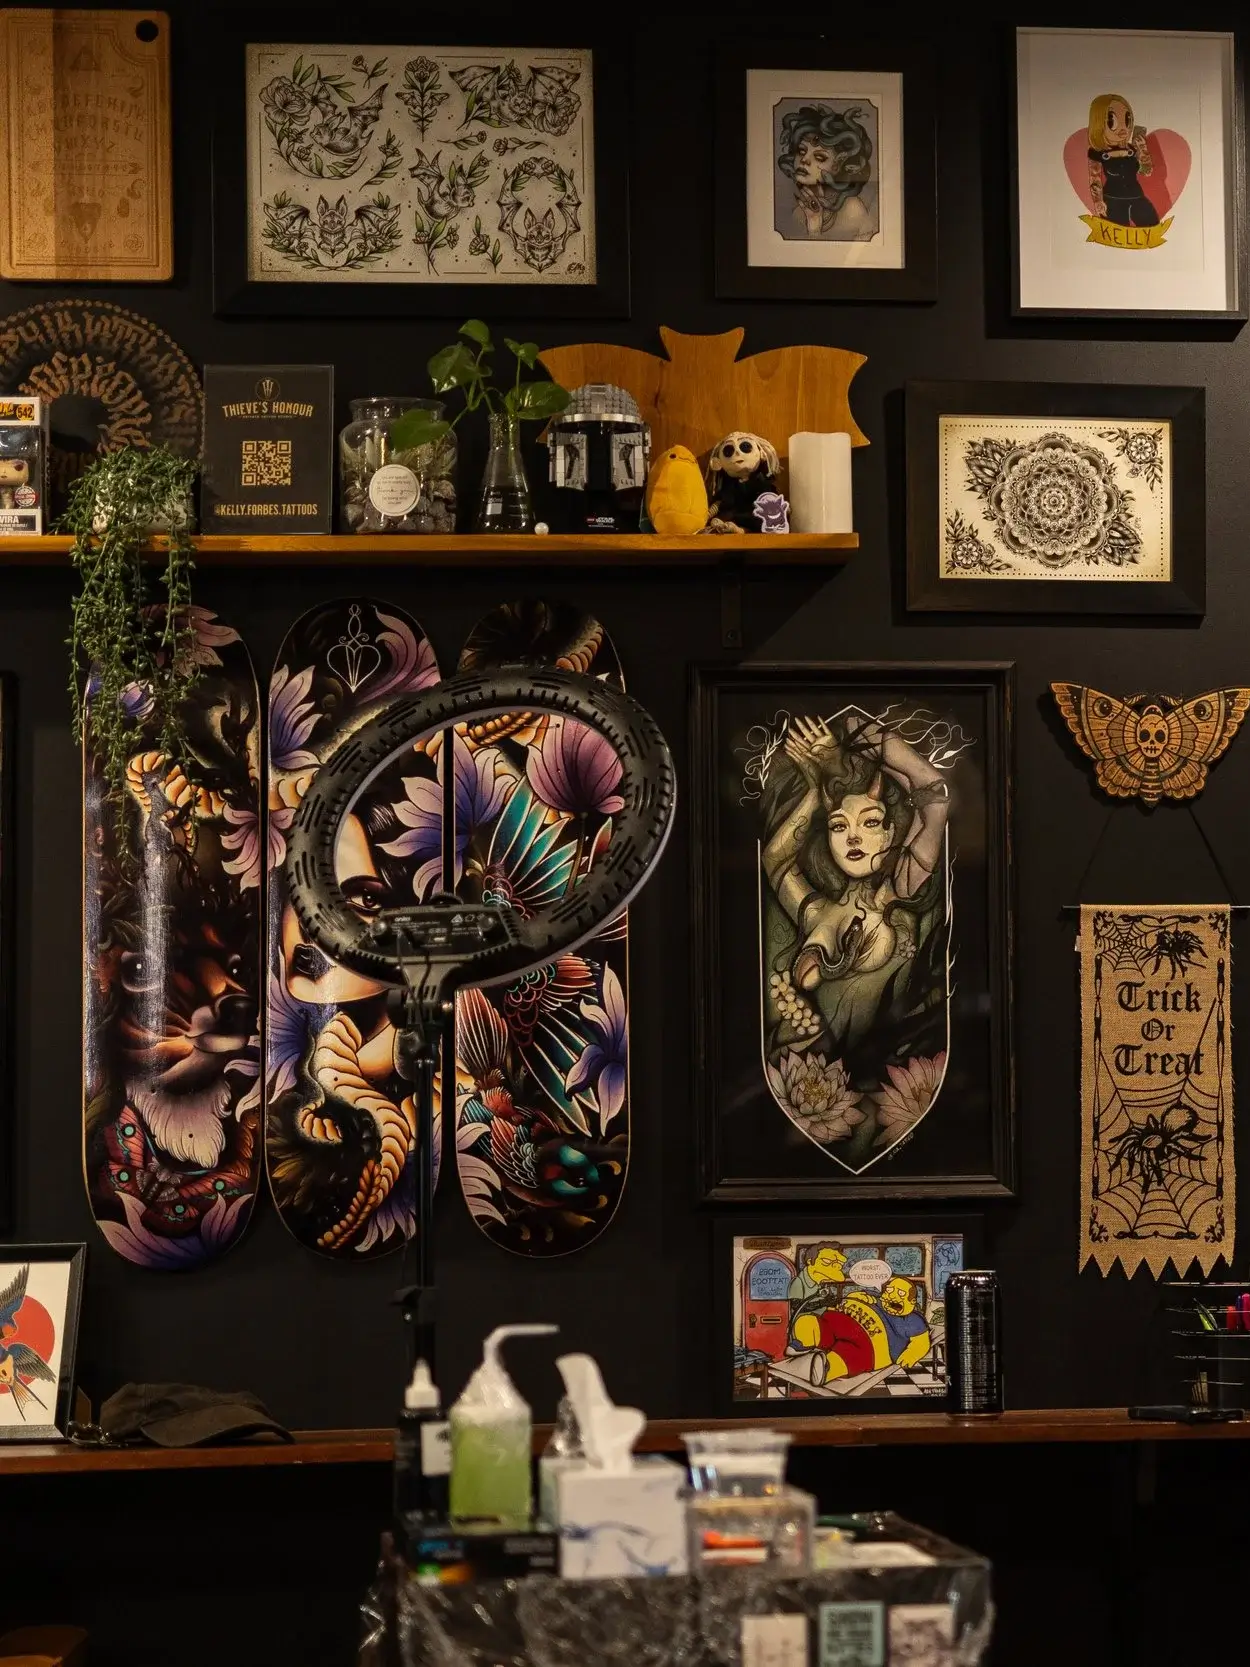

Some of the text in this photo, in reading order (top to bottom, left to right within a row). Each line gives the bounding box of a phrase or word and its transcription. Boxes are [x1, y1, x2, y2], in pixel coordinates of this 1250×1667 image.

[1100, 222, 1151, 245] KELLY
[17, 406, 33, 419] 542
[222, 401, 314, 417] THIEVE'S HONOUR
[1116, 981, 1202, 1012] Trick
[1141, 1018, 1176, 1041] Or
[1112, 1044, 1204, 1076] Treat
